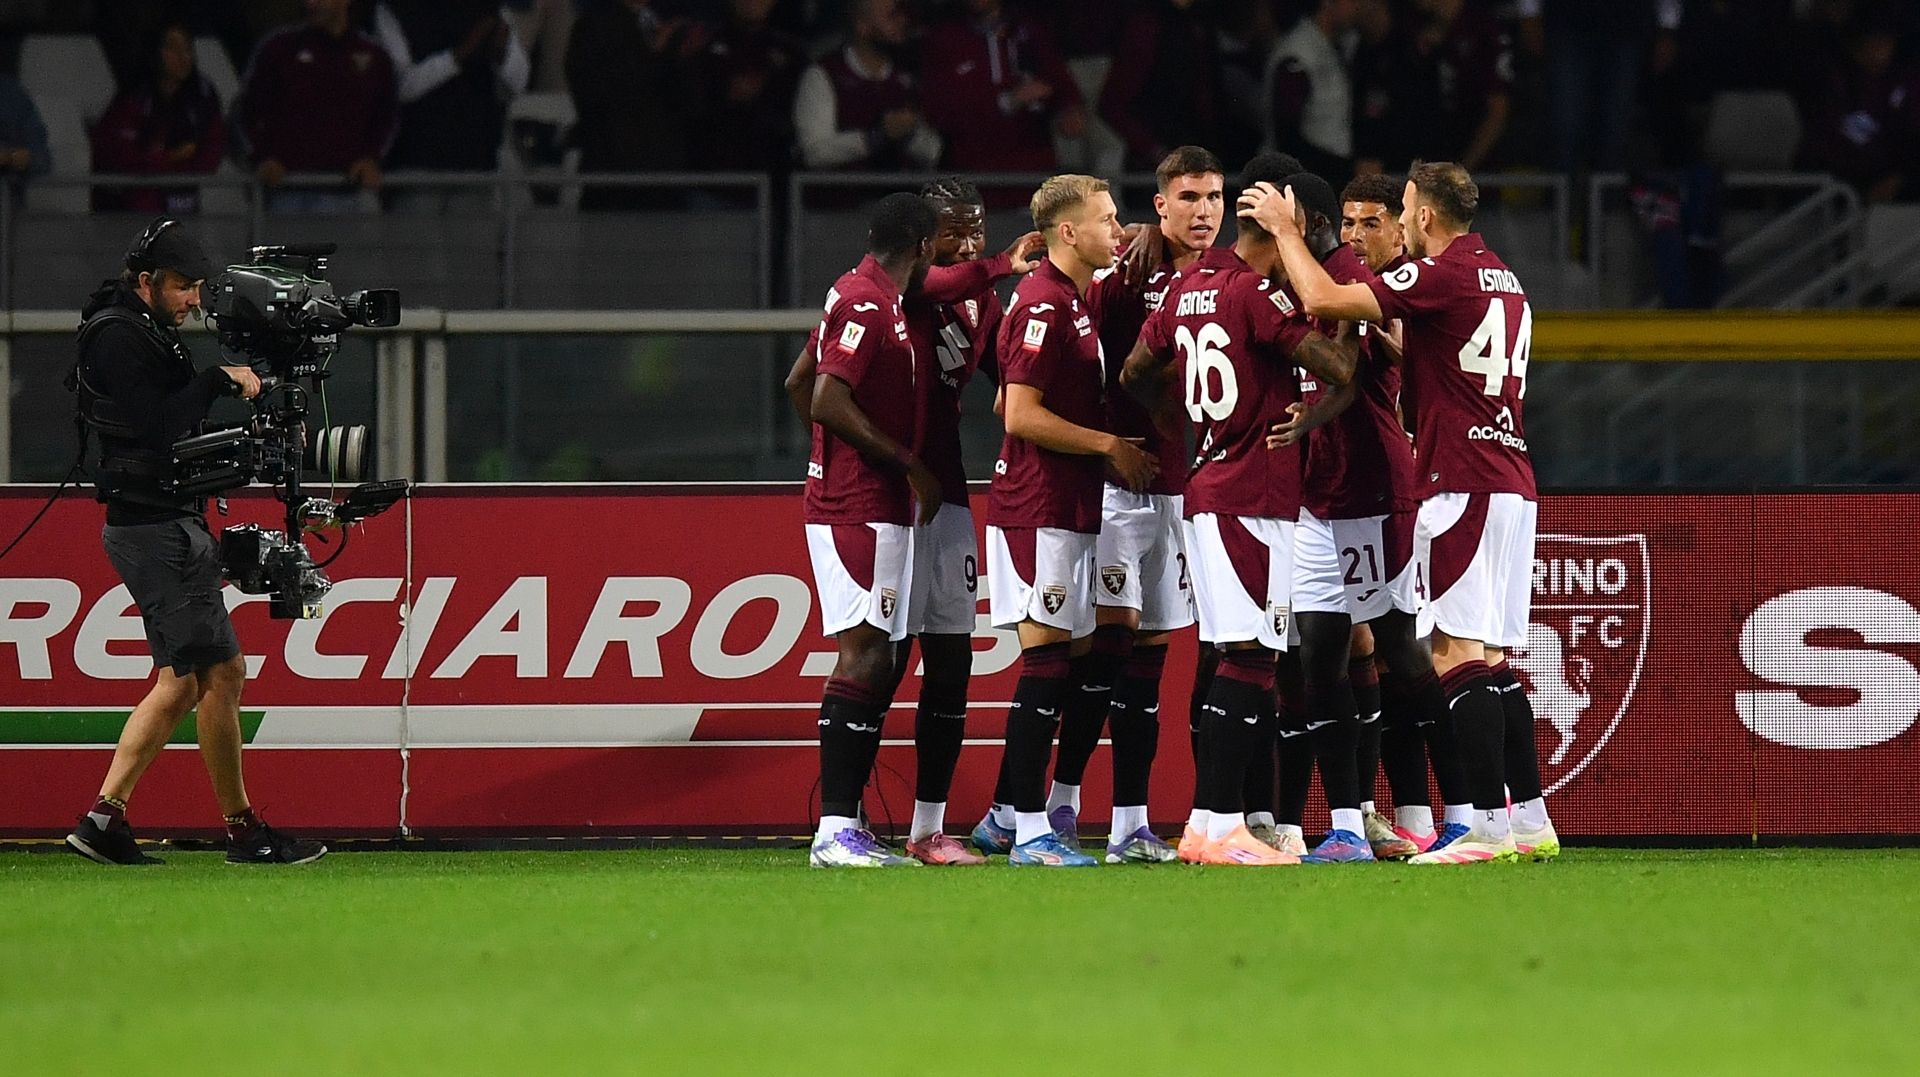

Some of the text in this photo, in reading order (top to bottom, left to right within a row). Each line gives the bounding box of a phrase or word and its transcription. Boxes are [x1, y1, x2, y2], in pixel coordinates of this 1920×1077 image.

[1459, 297, 1533, 400] 44
[1174, 322, 1239, 423] 26
[964, 554, 978, 593] 9
[1176, 552, 1190, 591] 2
[1341, 544, 1380, 585] 21
[1532, 558, 1628, 595] RINO
[1569, 615, 1624, 648] FC
[1734, 585, 1920, 750] S
